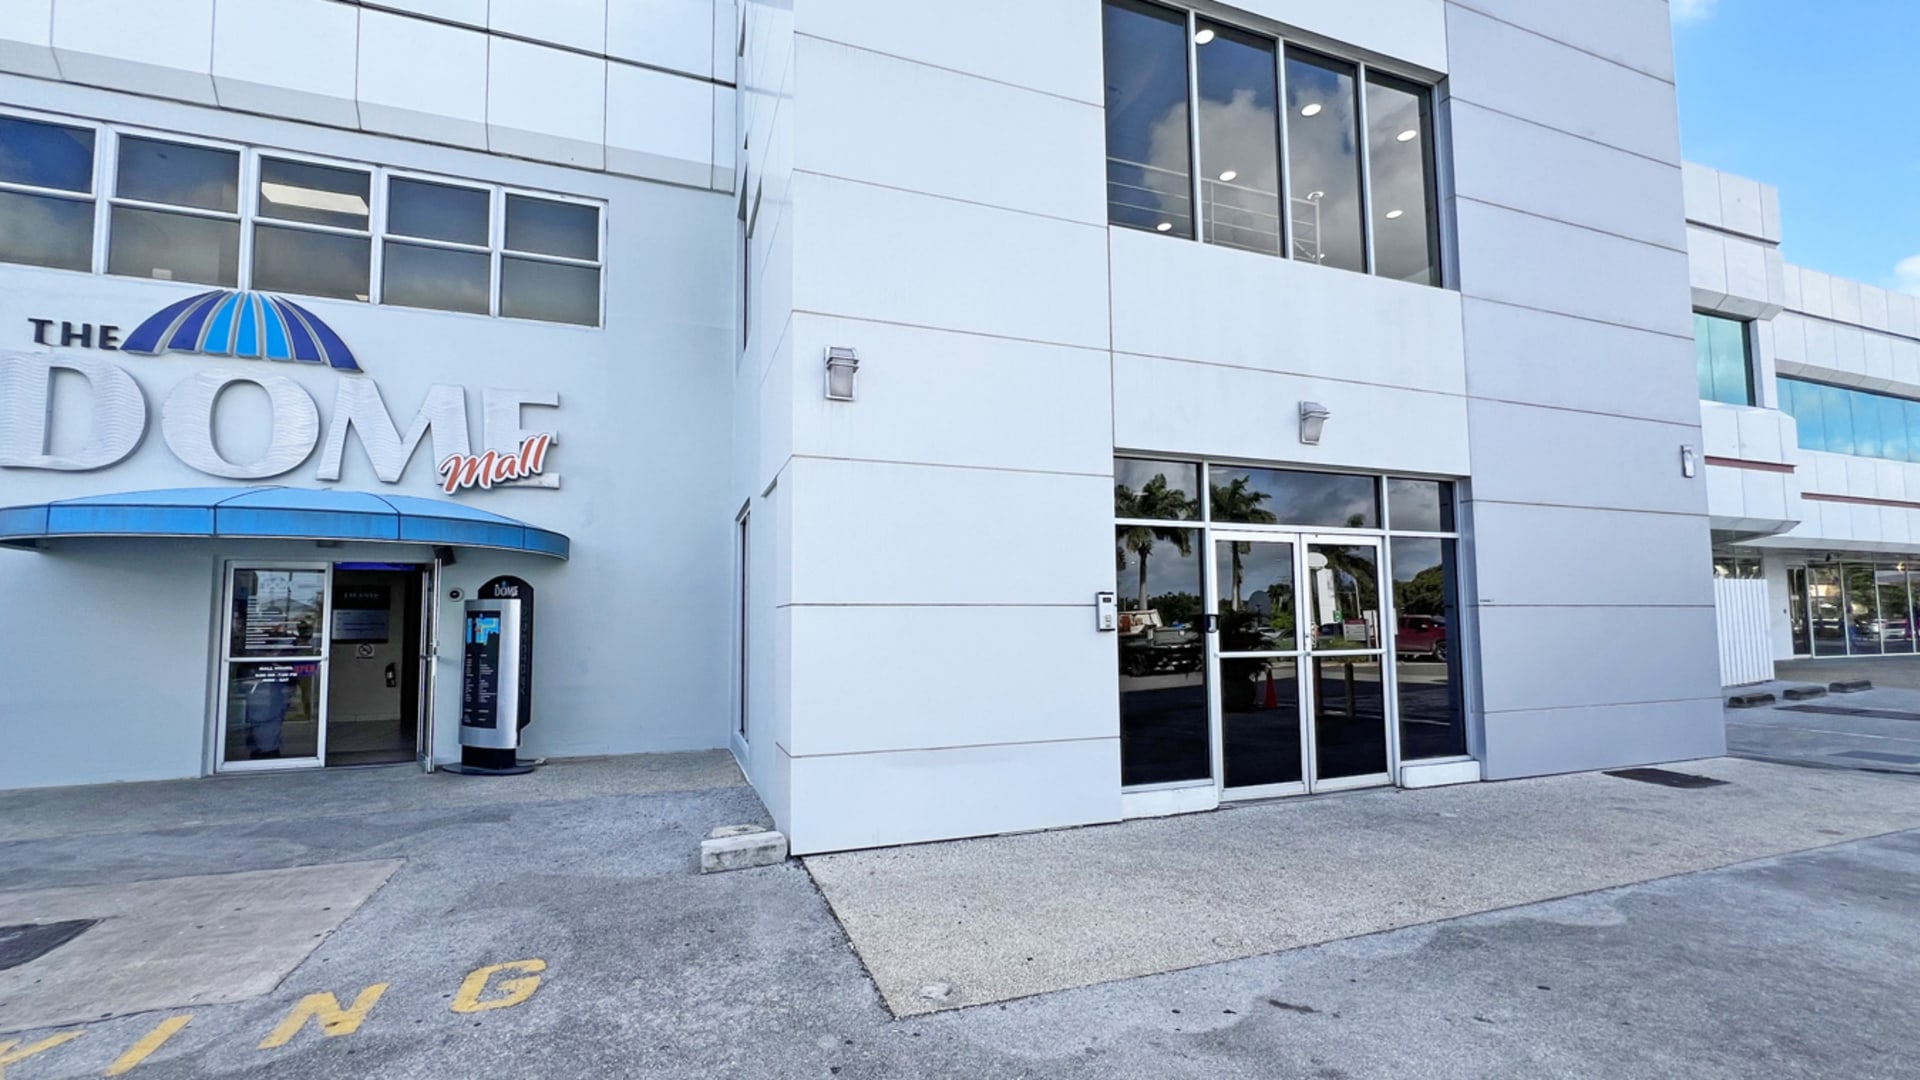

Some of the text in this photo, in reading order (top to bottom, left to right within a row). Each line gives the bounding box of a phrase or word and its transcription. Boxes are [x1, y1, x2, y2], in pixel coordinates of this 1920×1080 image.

[28, 318, 119, 350] THE
[0, 350, 559, 490] DOME
[438, 432, 551, 494] Mall
[494, 586, 519, 598] DOME
